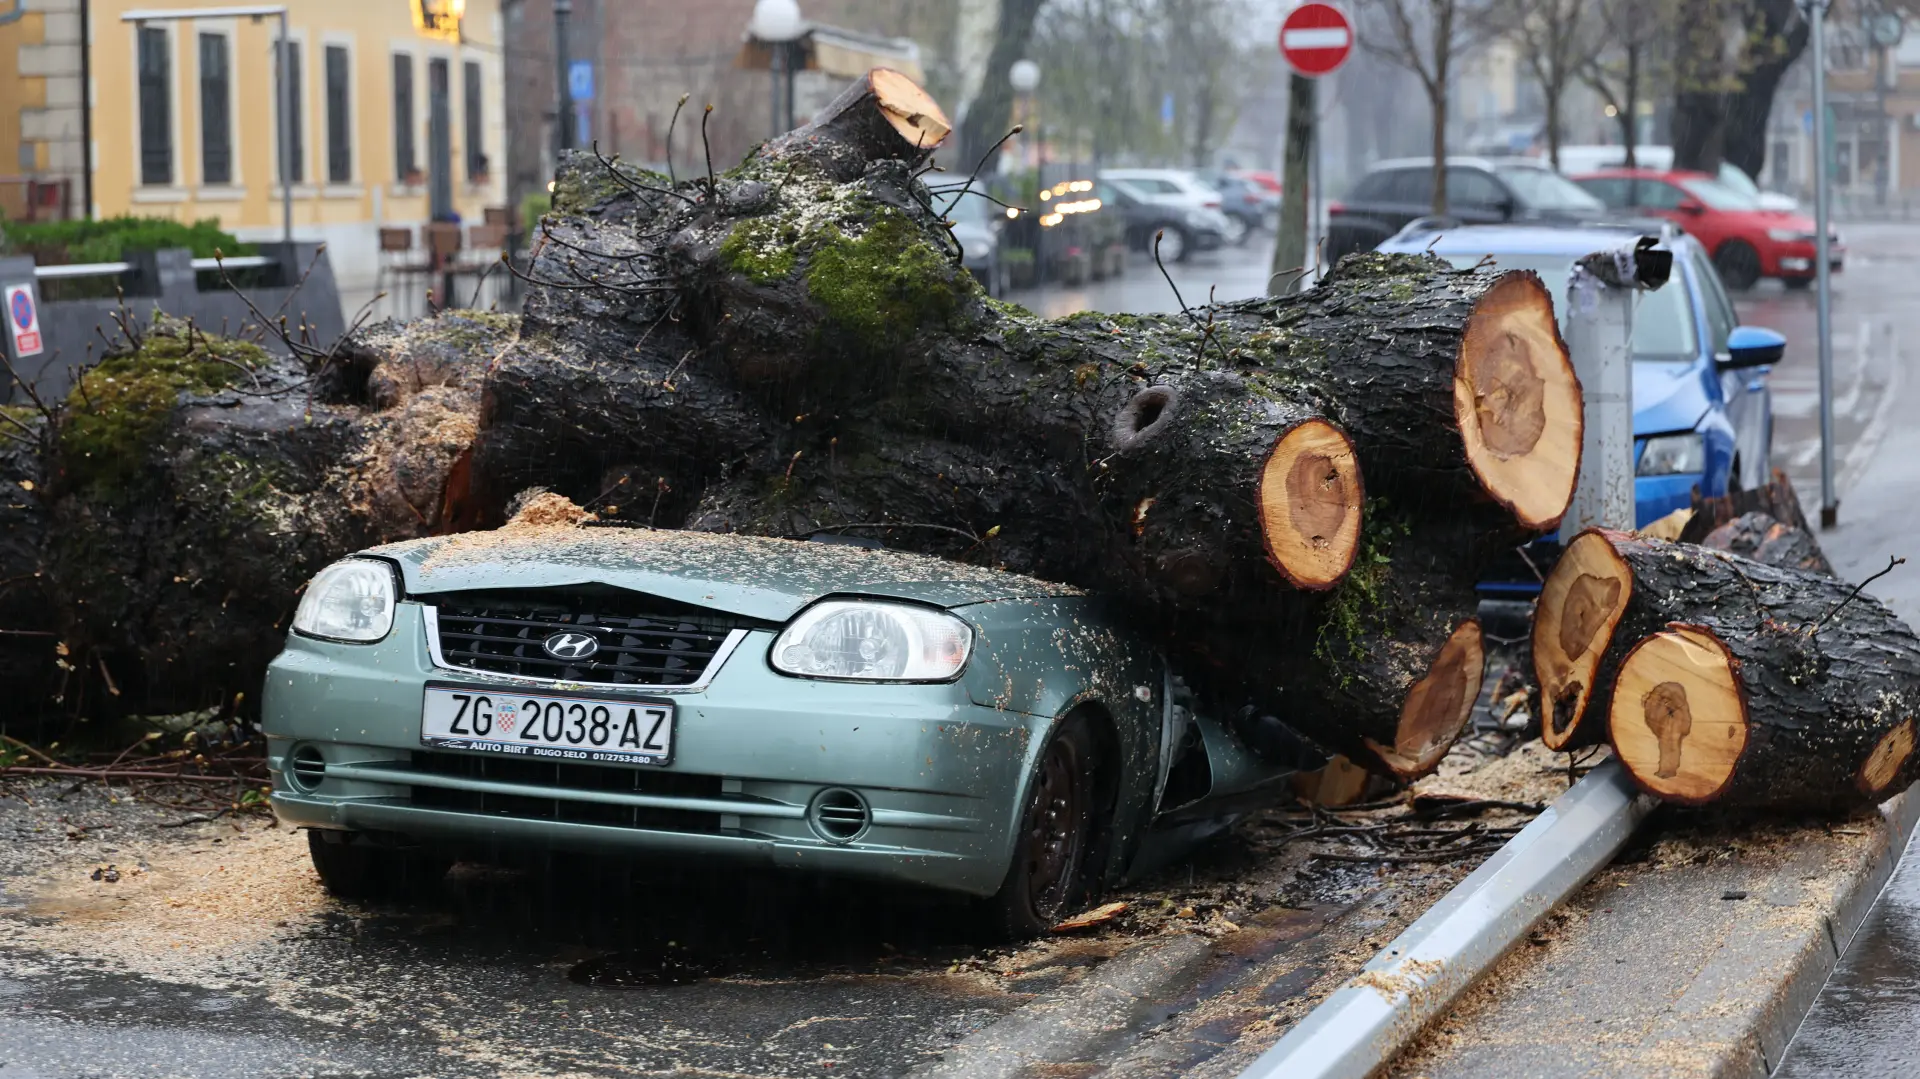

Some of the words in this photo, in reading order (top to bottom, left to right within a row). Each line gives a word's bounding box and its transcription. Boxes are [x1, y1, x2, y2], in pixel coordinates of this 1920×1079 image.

[450, 694, 493, 736] ZG
[469, 742, 502, 752] AUTO
[503, 744, 529, 755] BIRT
[533, 748, 562, 758] DUGO
[563, 750, 588, 760] SELO
[592, 752, 651, 764] 01/2753-880
